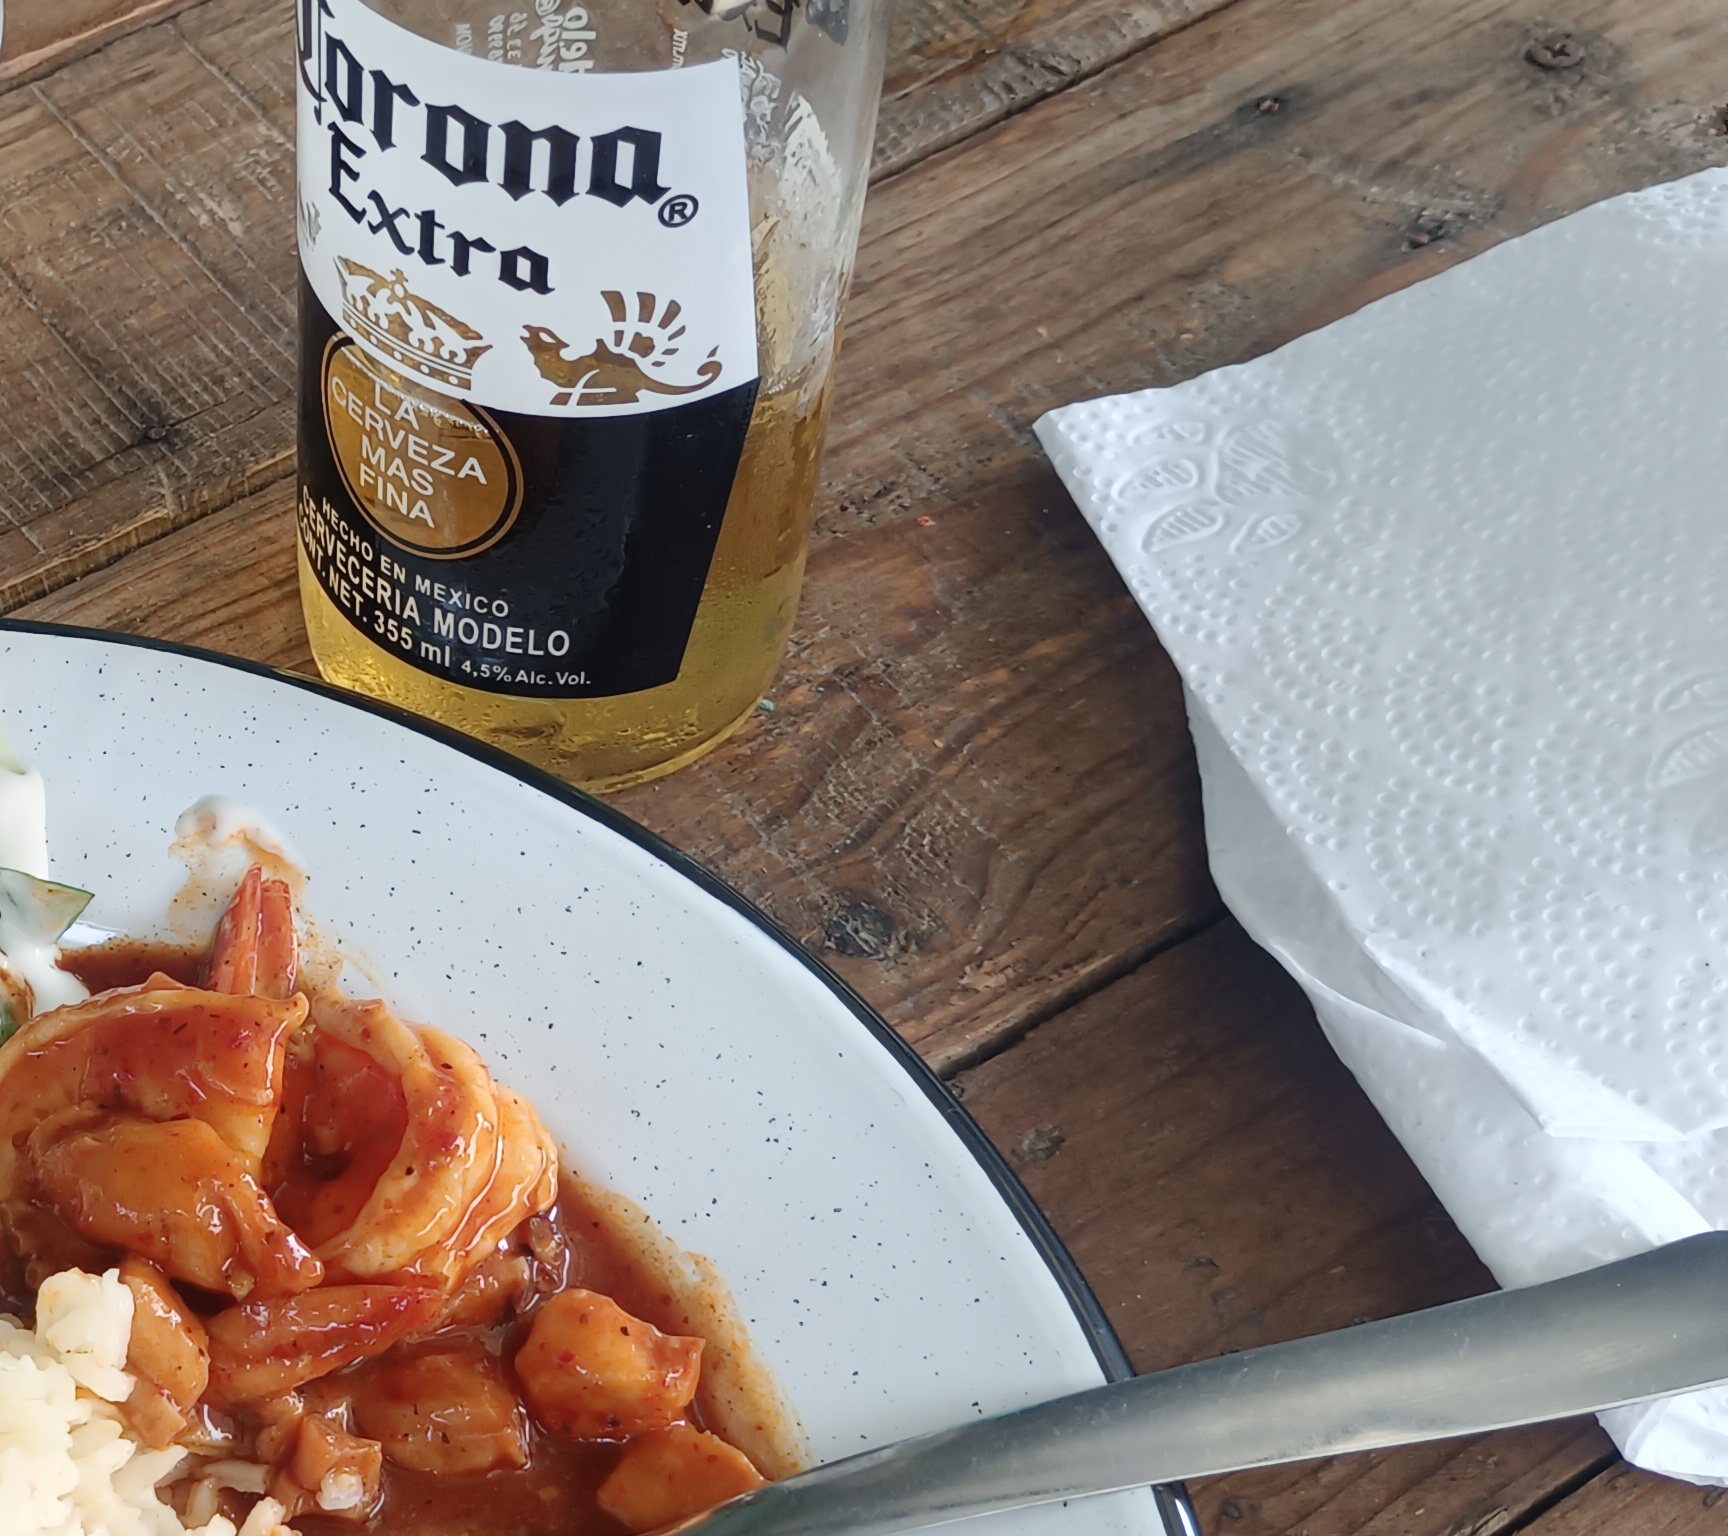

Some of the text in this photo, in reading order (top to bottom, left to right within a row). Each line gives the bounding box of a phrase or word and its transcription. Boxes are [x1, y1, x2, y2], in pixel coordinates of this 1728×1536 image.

[327, 120, 556, 296] Extra
[330, 375, 488, 486] CERVEZA
[374, 380, 420, 431] LA
[359, 461, 435, 529] FINA
[361, 436, 434, 496] MAS
[298, 502, 327, 579] CONT.
[328, 564, 368, 624] NET.
[374, 609, 414, 652] 355
[420, 640, 452, 669] ml
[460, 658, 513, 684] 4,5%
[303, 484, 571, 658] CERVECERIA MODELO
[322, 496, 510, 618] HECHO EN MEXICO
